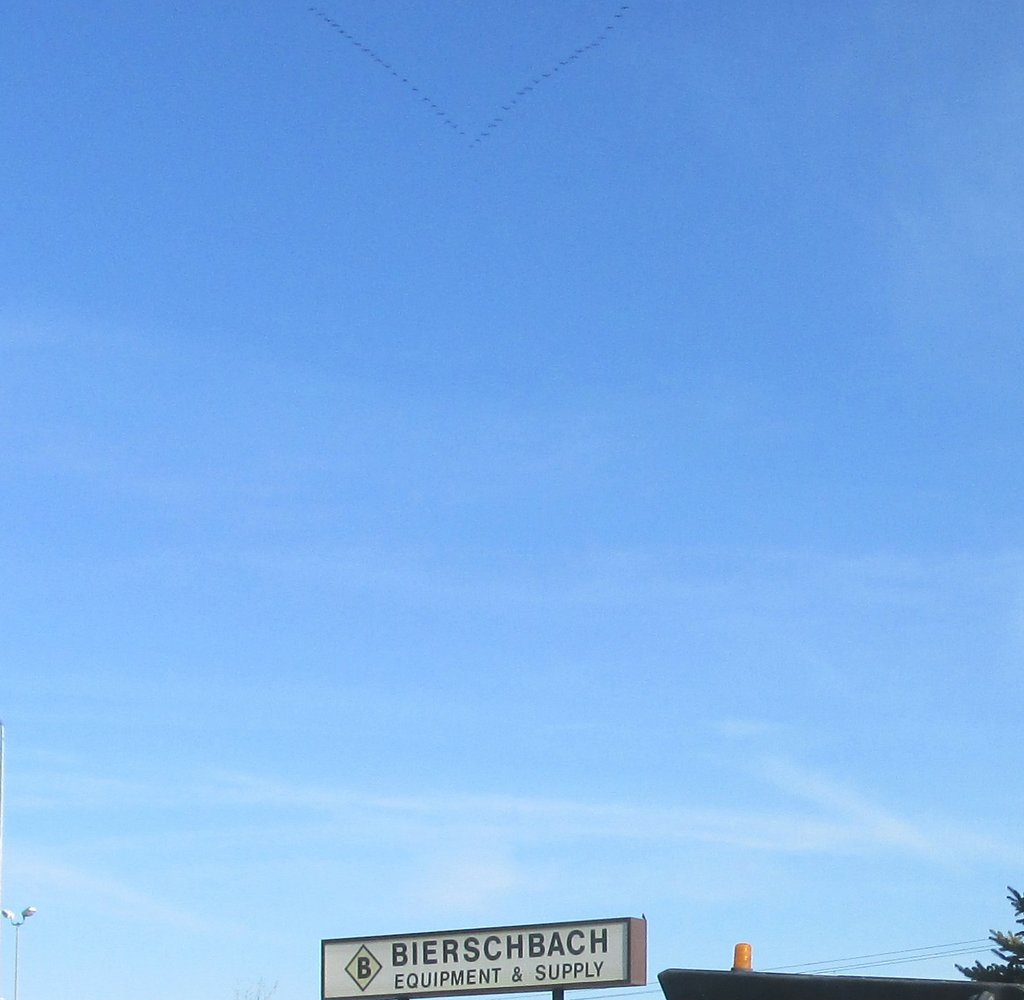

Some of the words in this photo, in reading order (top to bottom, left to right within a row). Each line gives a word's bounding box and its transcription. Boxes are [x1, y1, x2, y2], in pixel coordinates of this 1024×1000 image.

[391, 928, 608, 967] BIERSCHBACH
[357, 956, 371, 980] B
[394, 967, 502, 989] EQUIPMENT
[511, 966, 523, 982] &
[535, 961, 604, 981] SUPPLY
